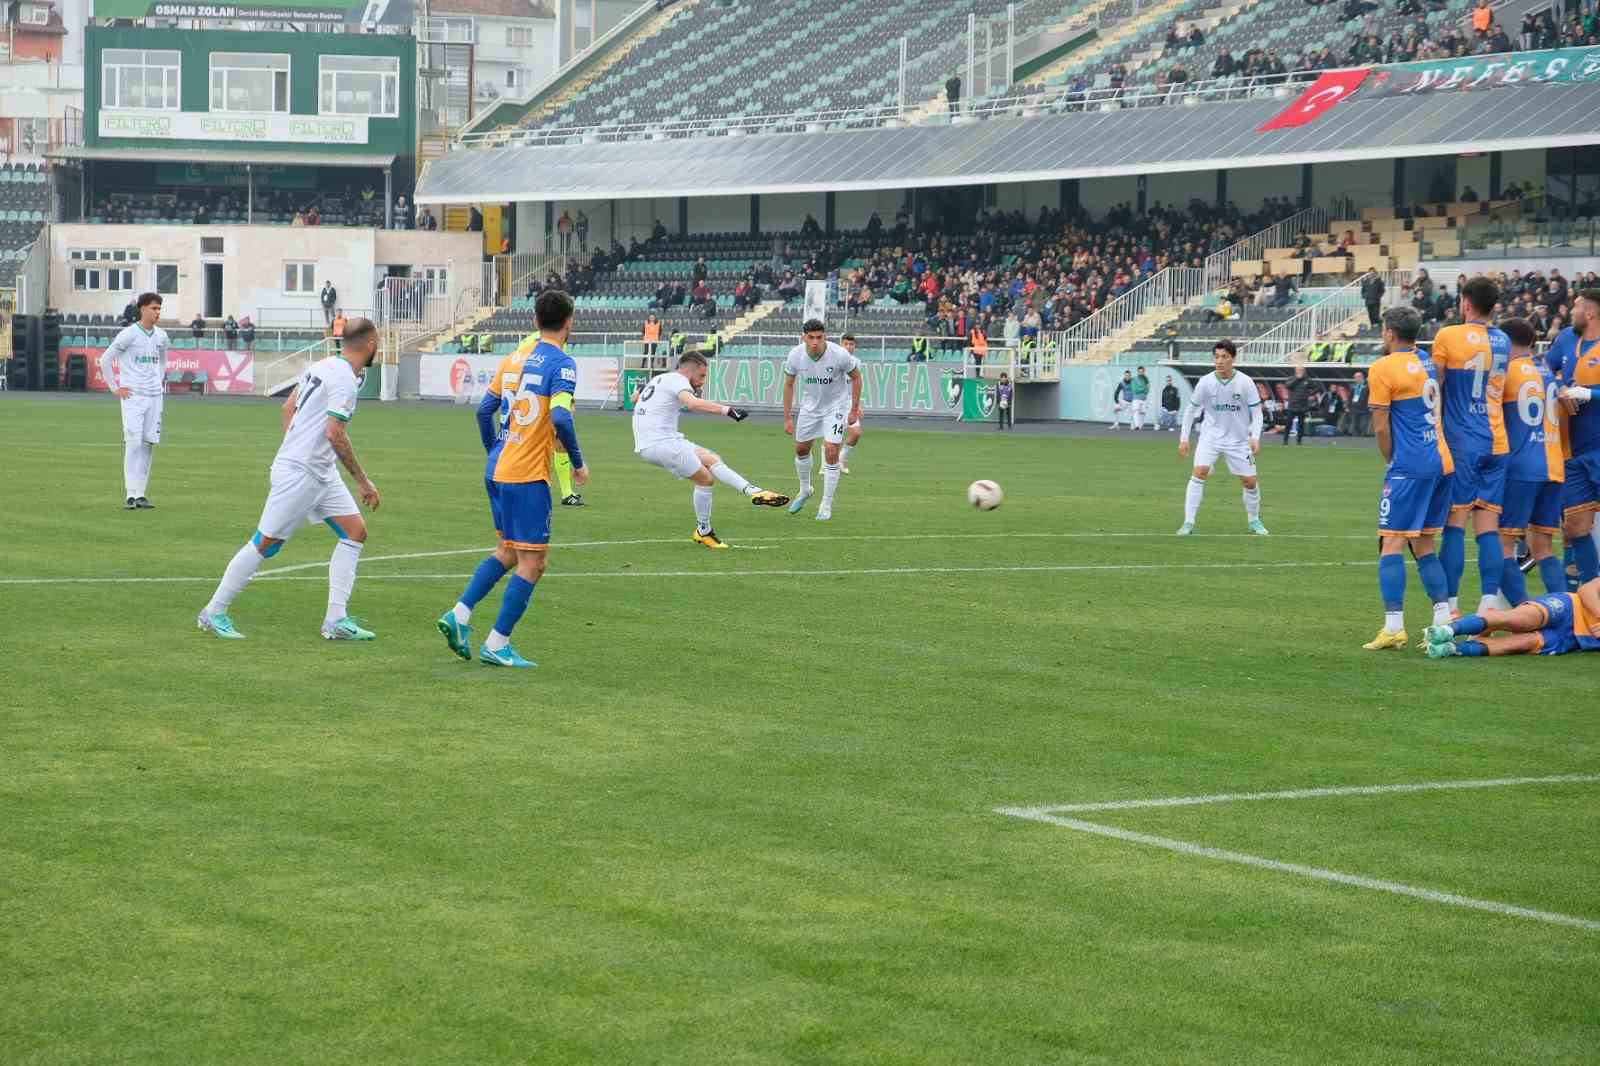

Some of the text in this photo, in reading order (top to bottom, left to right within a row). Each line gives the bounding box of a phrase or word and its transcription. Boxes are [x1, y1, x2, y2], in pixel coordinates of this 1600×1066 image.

[155, 5, 196, 16] OSMAN
[198, 6, 235, 17] ZOLAN
[500, 371, 542, 426] 55
[1423, 378, 1441, 424] 9
[832, 423, 844, 435] 14
[1380, 498, 1391, 517] 9
